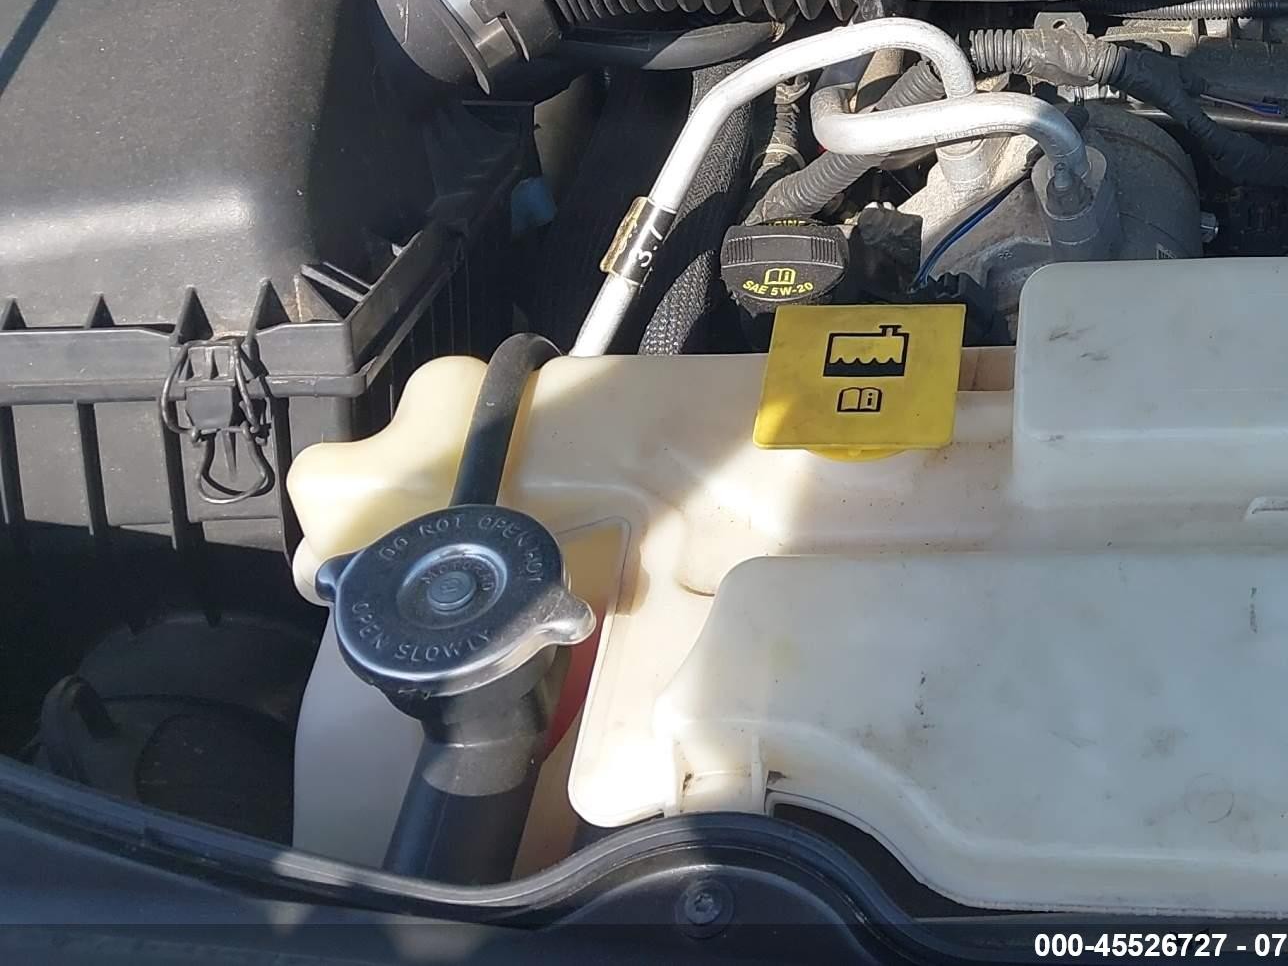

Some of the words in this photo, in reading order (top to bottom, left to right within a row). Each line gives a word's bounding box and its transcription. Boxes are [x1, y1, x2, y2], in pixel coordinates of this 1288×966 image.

[742, 280, 769, 295] SAE
[770, 282, 814, 296] 5W-20
[378, 536, 409, 562] DO
[417, 513, 466, 538] NOT
[351, 601, 391, 650] OPEN
[393, 629, 490, 663] SLOWLY
